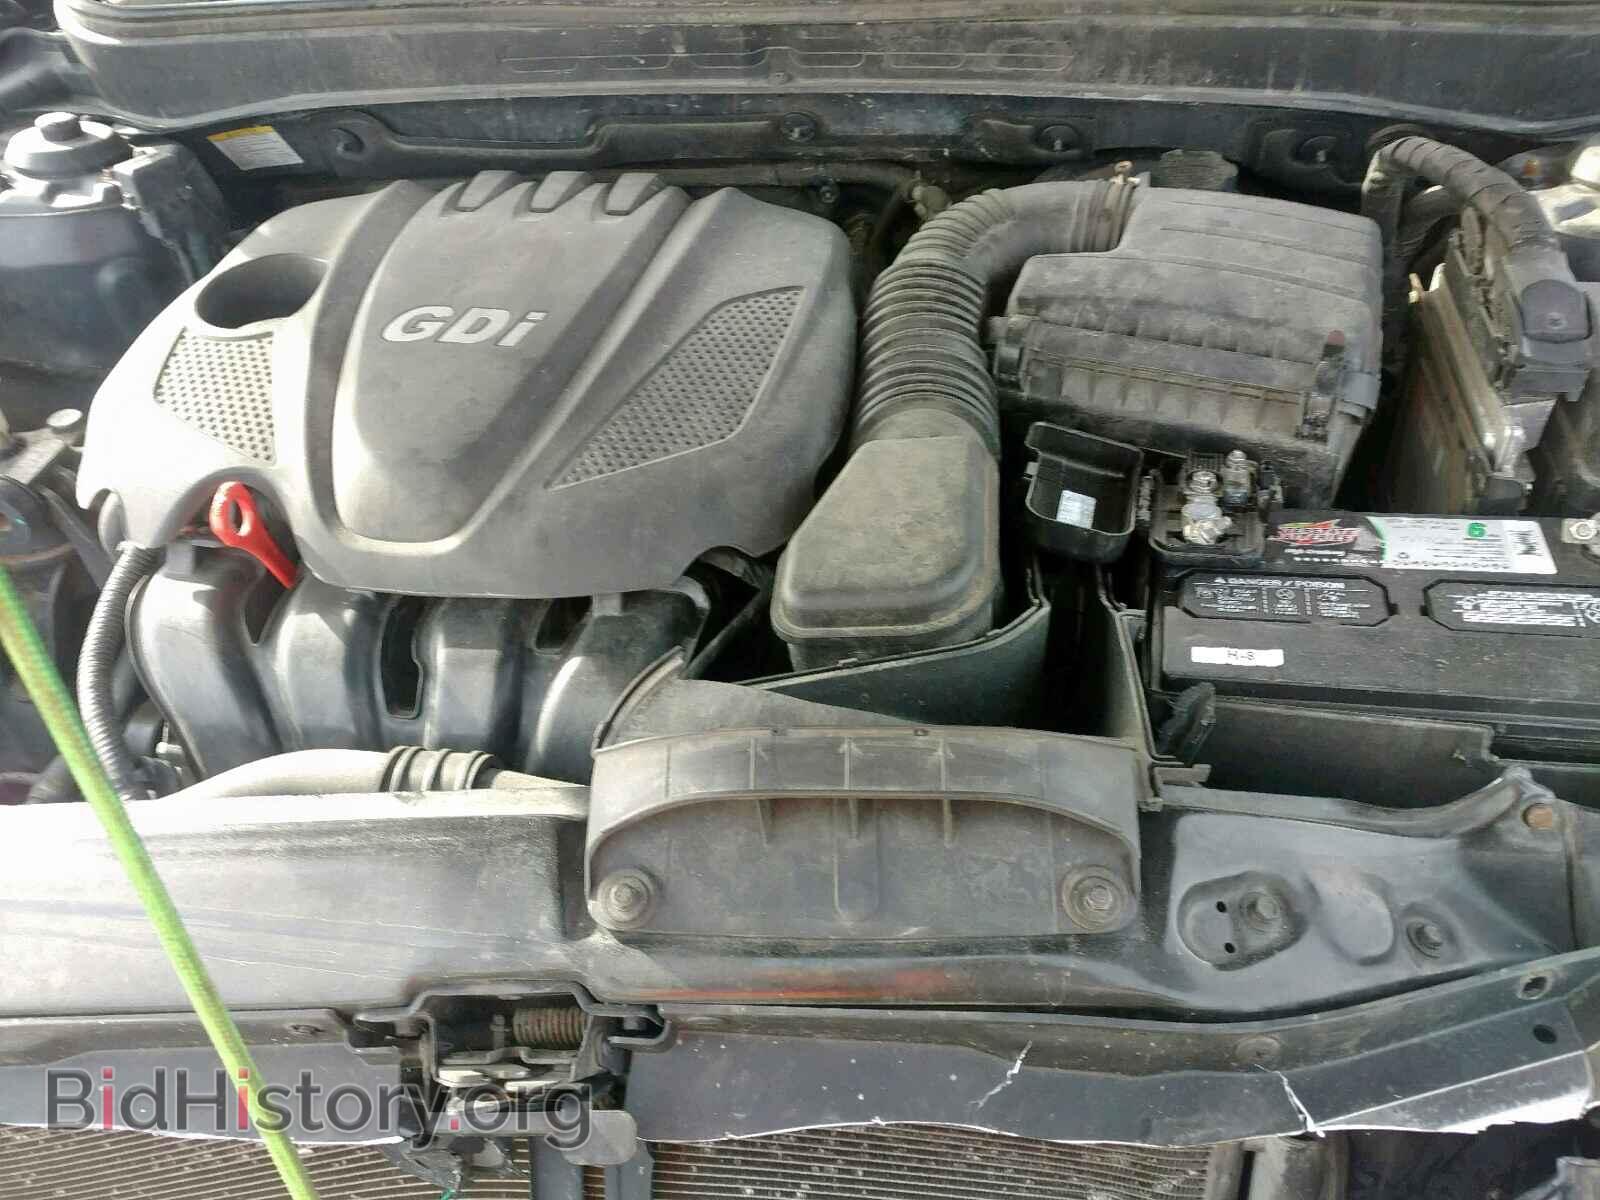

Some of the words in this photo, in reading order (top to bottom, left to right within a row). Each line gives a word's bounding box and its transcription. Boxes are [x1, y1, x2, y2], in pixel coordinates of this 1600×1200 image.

[382, 305, 547, 347] GDi
[1467, 522, 1488, 538] 6
[1294, 579, 1345, 589] POISON
